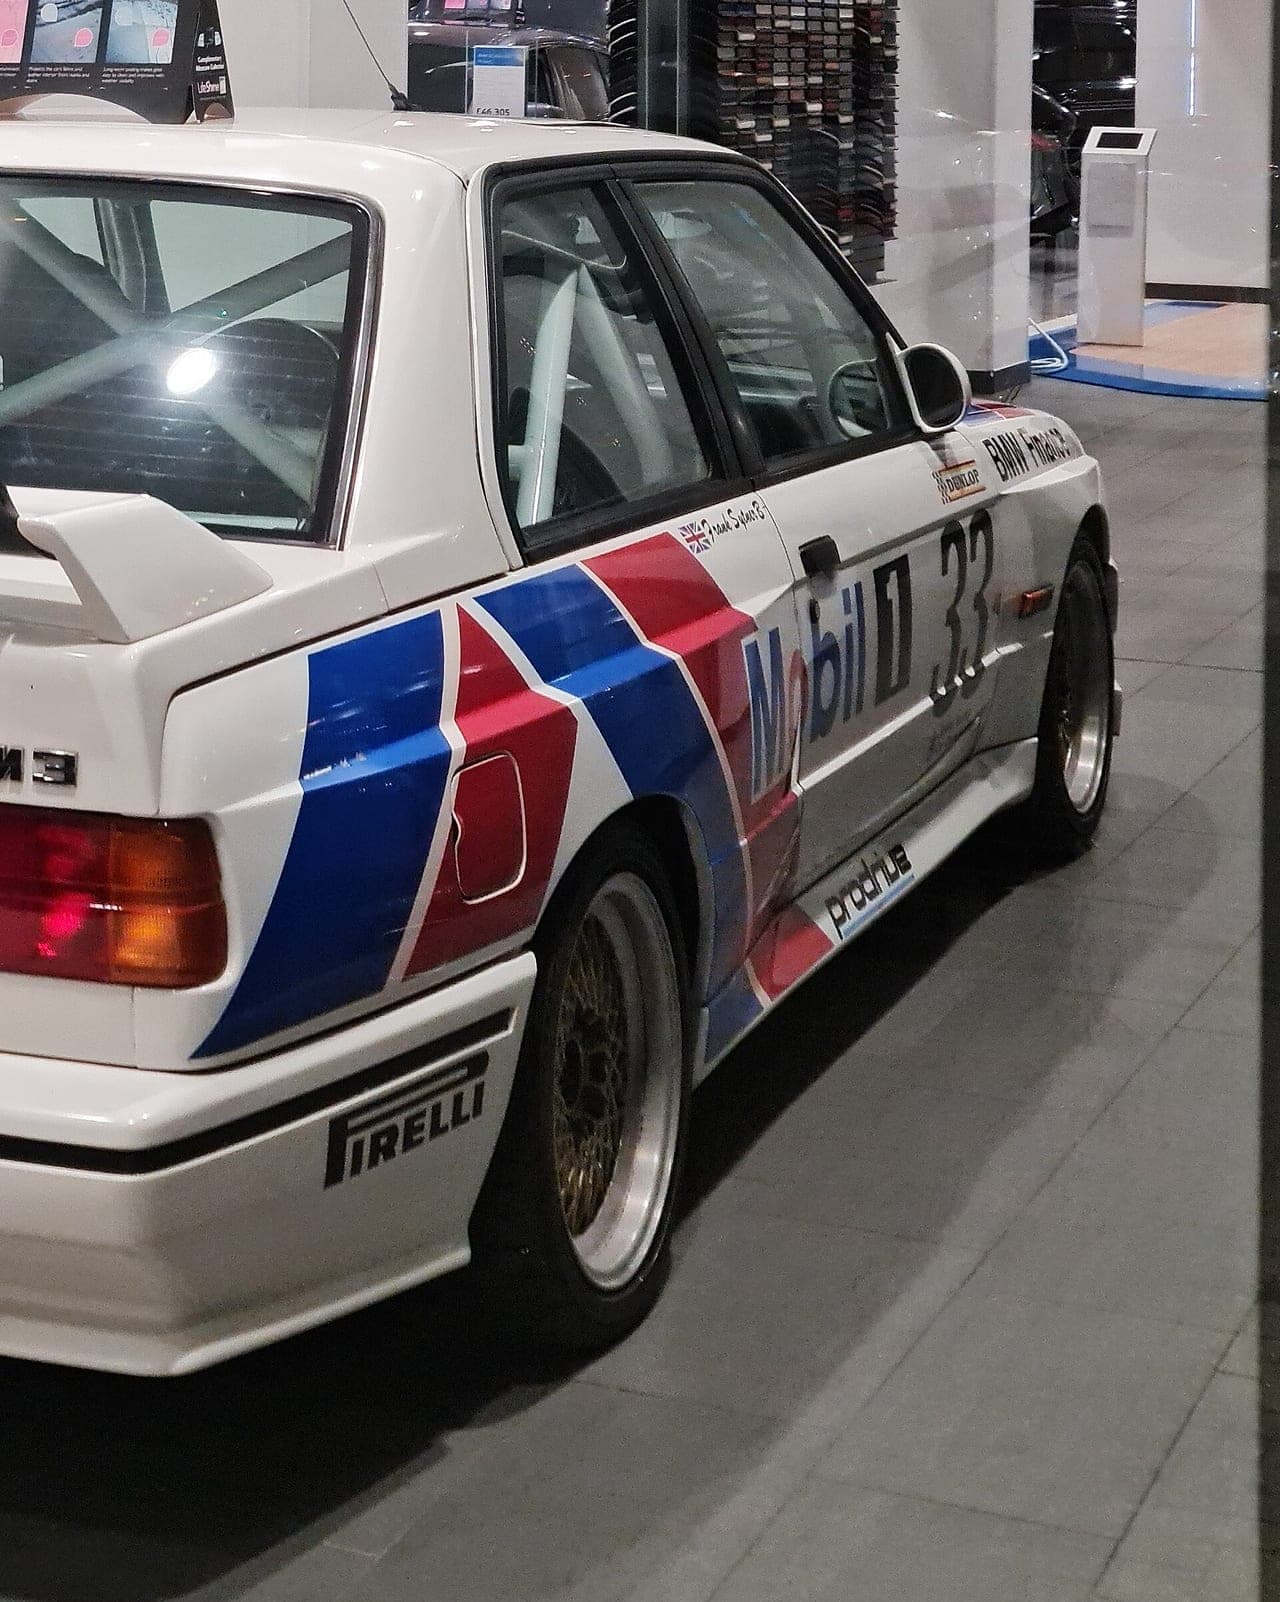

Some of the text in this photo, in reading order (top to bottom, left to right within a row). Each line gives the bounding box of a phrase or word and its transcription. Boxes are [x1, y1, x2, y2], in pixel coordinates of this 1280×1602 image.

[944, 468, 980, 493] DUNLOP
[982, 431, 1030, 482] BMW
[928, 508, 995, 718] 33
[742, 580, 867, 802] Mobil
[824, 844, 912, 940] prodrive
[323, 1050, 490, 1191] PIRELLI
